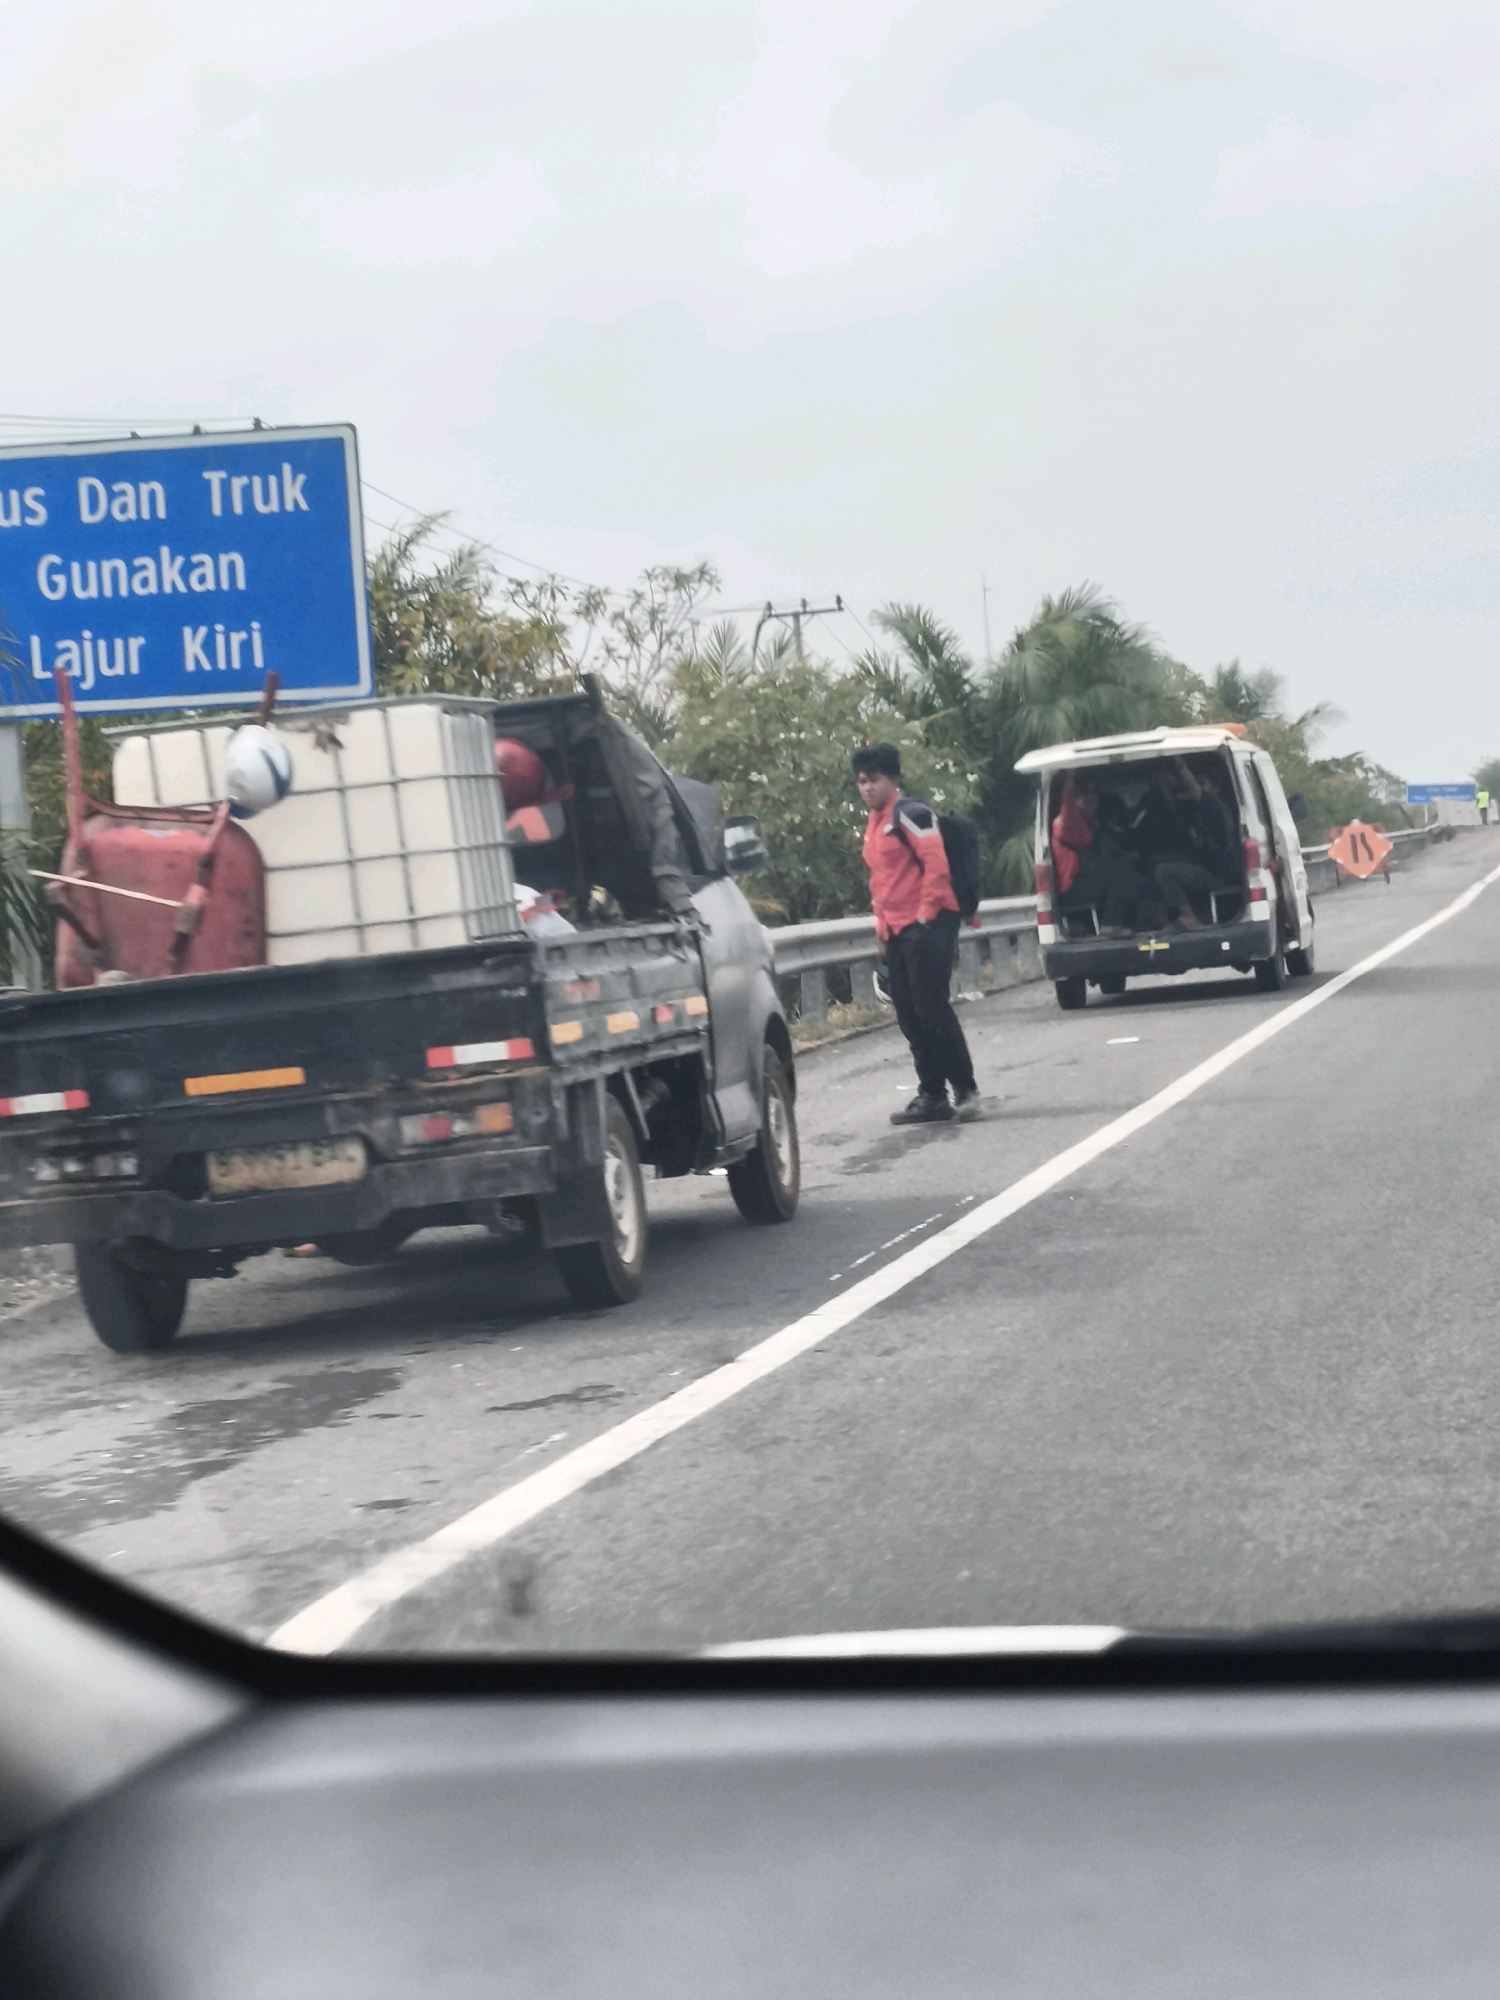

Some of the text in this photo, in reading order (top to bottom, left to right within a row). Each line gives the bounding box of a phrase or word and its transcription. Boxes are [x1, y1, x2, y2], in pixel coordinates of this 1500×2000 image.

[77, 476, 167, 524] Dan
[201, 462, 311, 518] Truk
[36, 545, 248, 601] Gunakan
[29, 621, 265, 691] Lajur Kiri
